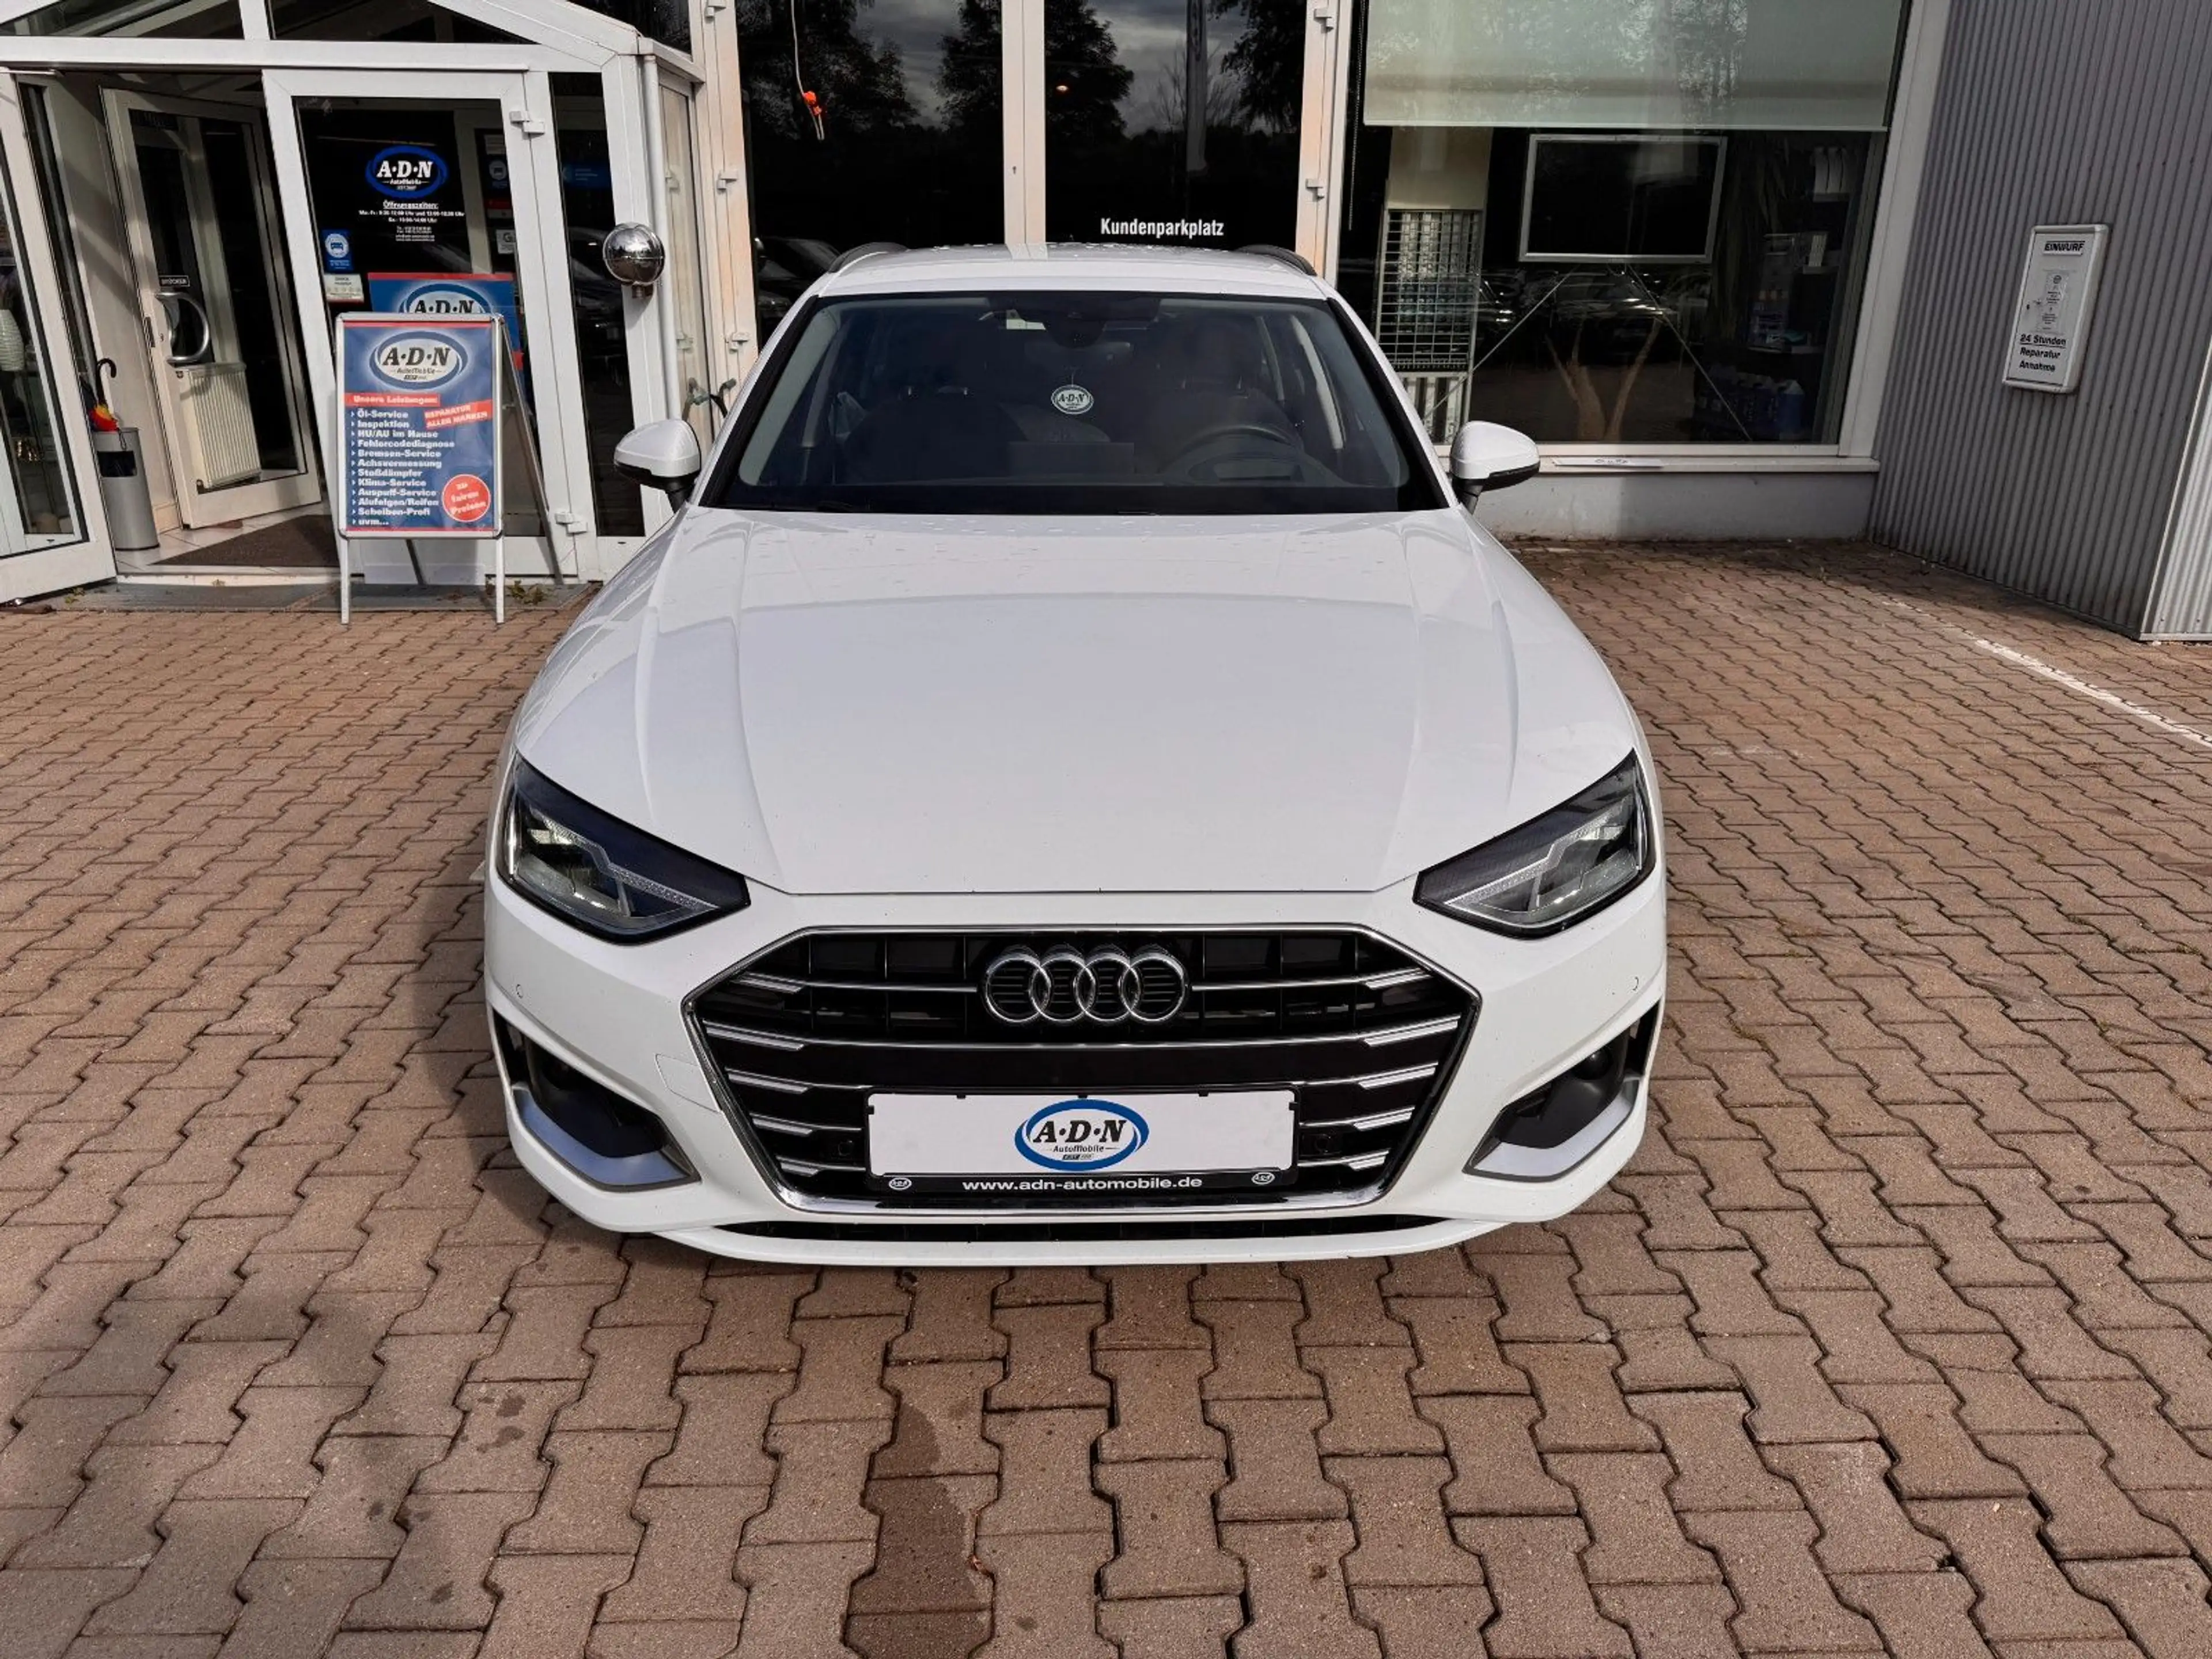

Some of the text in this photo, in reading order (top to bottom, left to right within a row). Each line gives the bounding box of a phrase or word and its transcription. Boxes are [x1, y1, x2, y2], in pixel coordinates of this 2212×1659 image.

[1101, 218, 1224, 239] Kundenparkplatz
[2044, 243, 2084, 252] EINWURF
[2020, 334, 2067, 346] 24 Stunden
[2020, 347, 2061, 359] Reparatur
[2020, 361, 2056, 372] Annahme
[357, 408, 408, 418] Öl-Service
[453, 411, 488, 423] MARKEN
[357, 421, 410, 430] Inspektion
[357, 430, 439, 438] HU/AU im Hause
[357, 440, 455, 449] Fehlercodediagnose
[358, 449, 441, 458] Bremsen-Service
[358, 459, 442, 469] Achsvermessung
[358, 469, 423, 479] Stoßdämpfer
[358, 479, 426, 487] Klima-Service
[358, 488, 437, 497] Auspuff-Service
[358, 498, 439, 507] Alufelgen/Reifen
[358, 507, 431, 516] Scheiben-Profi
[962, 1176, 1203, 1190] www.adn-automobile.de
